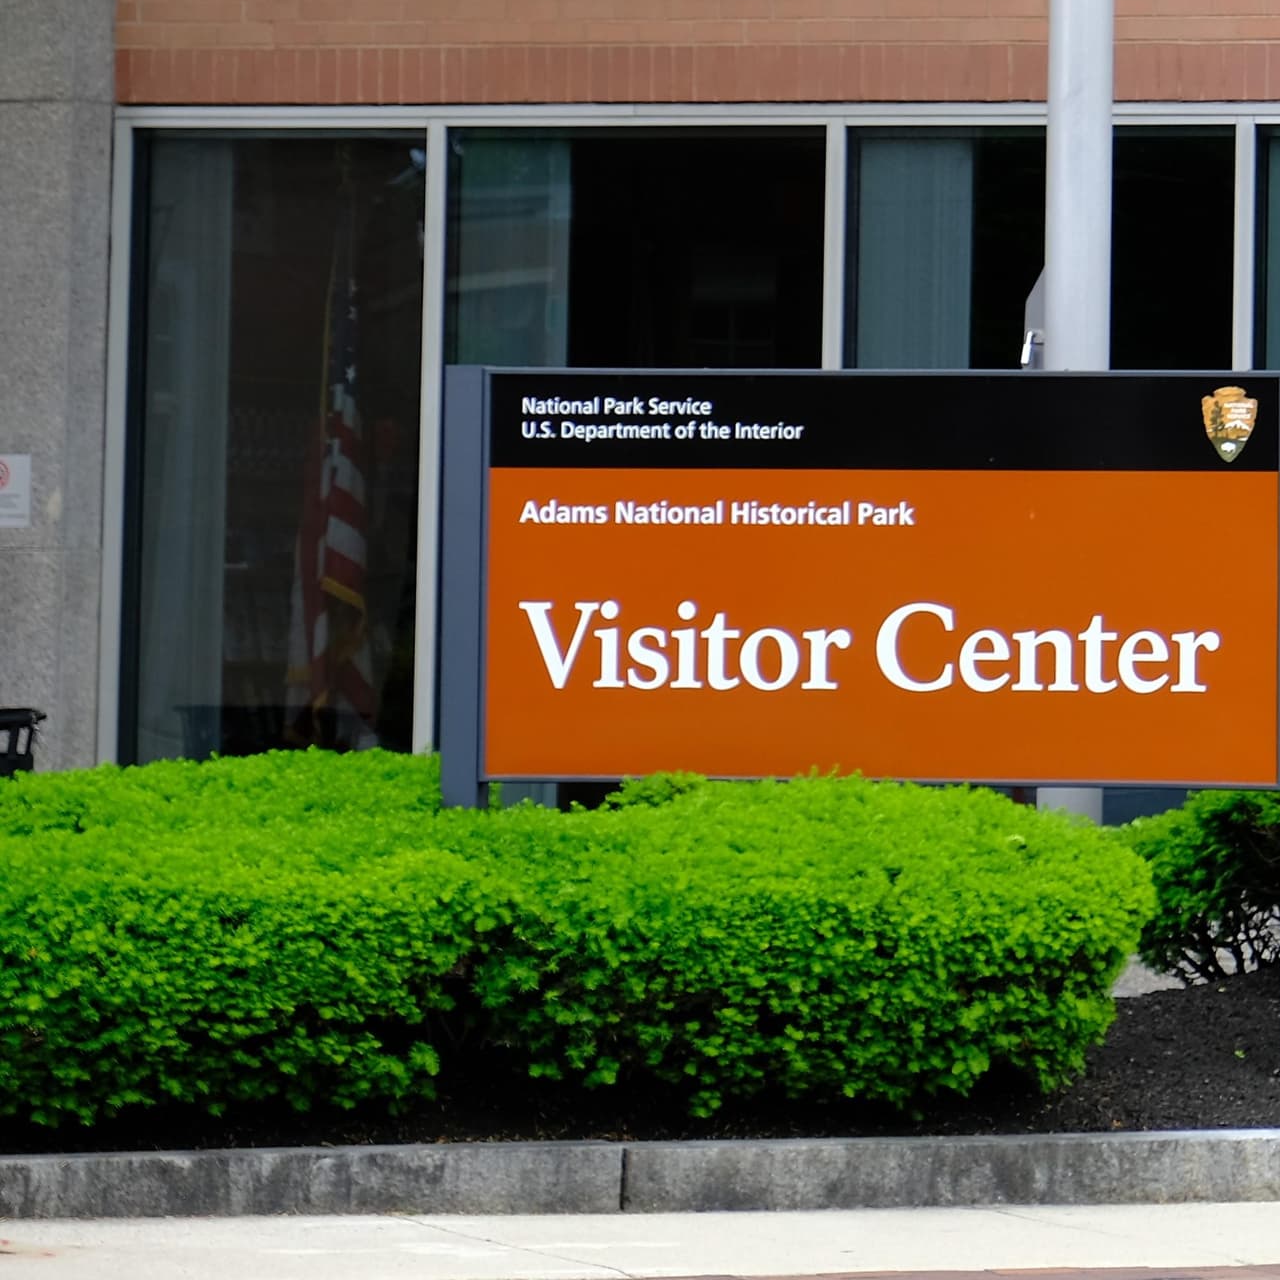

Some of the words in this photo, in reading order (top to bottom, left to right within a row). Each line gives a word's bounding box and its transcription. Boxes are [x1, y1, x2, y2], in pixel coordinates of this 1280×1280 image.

[521, 396, 600, 415] National
[603, 396, 644, 415] Park
[648, 397, 712, 416] Service
[521, 420, 556, 439] U.S.
[560, 421, 671, 443] Department
[674, 420, 696, 440] of
[698, 421, 731, 440] the
[735, 421, 804, 440] Interior
[519, 499, 609, 524] Adams
[615, 500, 724, 525] National
[731, 500, 851, 526] Historical
[857, 501, 915, 526] Park
[518, 599, 852, 691] Visitor
[876, 601, 1221, 694] Center
